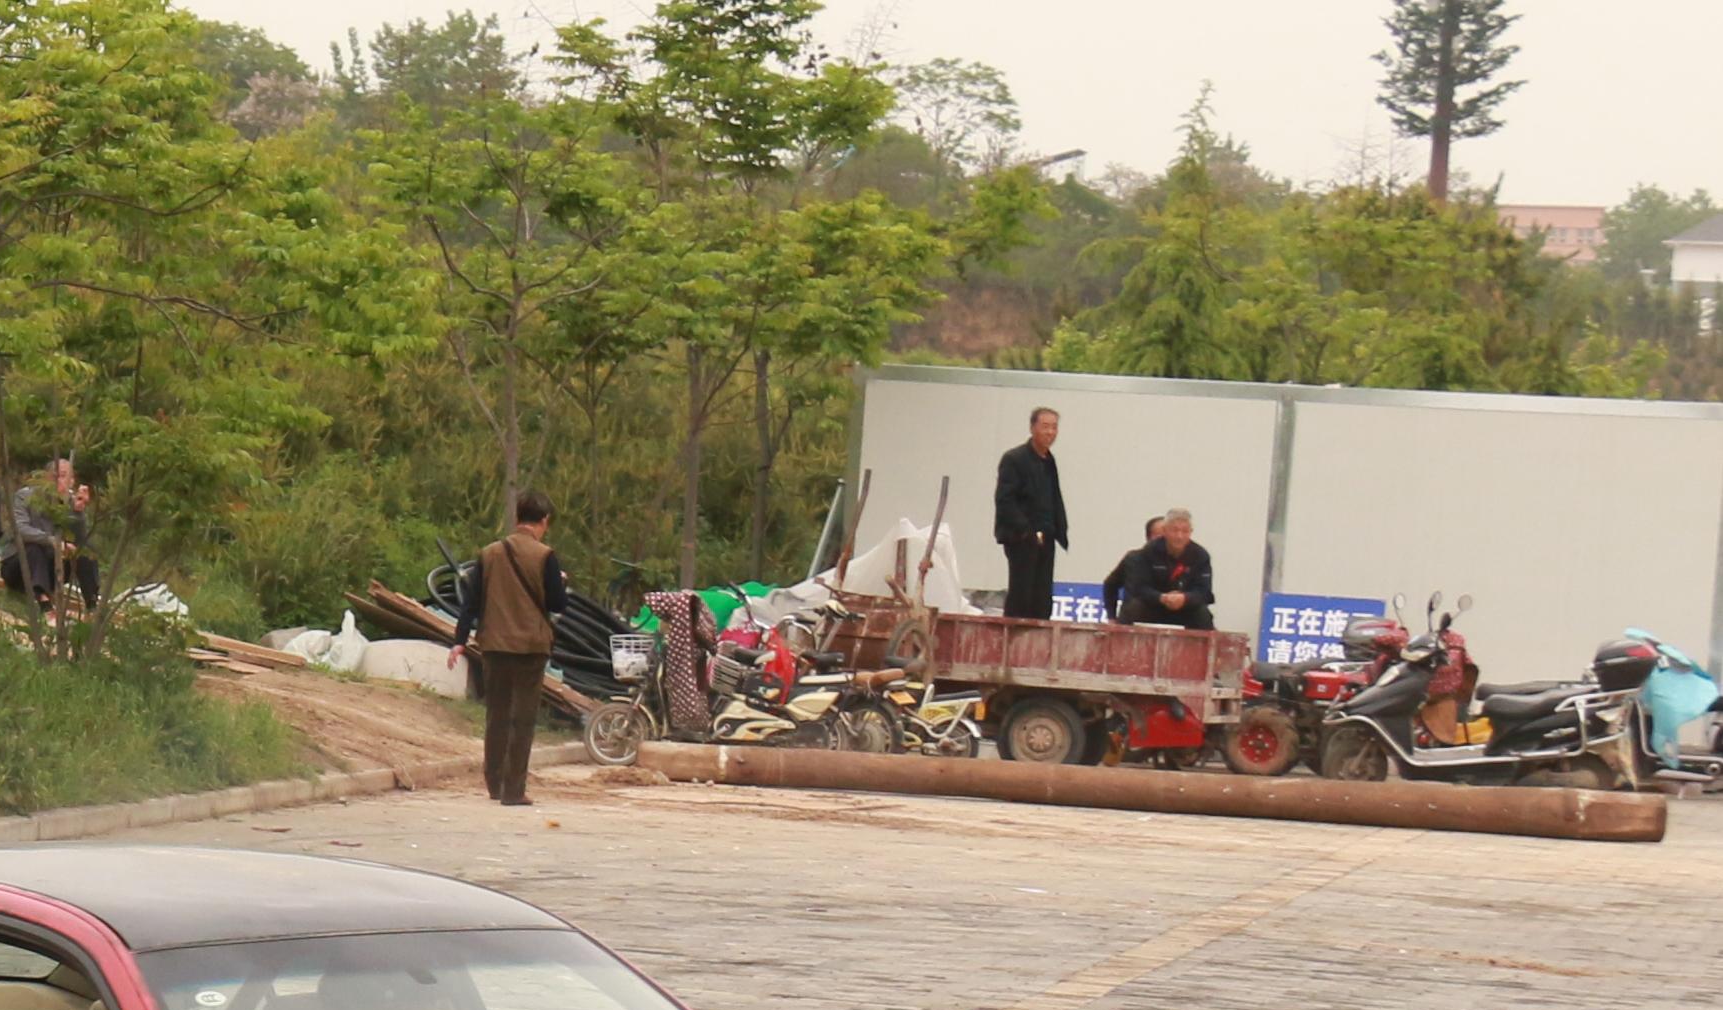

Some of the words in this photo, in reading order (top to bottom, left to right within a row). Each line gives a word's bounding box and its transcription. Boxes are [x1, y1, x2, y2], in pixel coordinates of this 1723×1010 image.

[1050, 596, 1123, 624] 正在
[1269, 607, 1375, 637] 正在施
